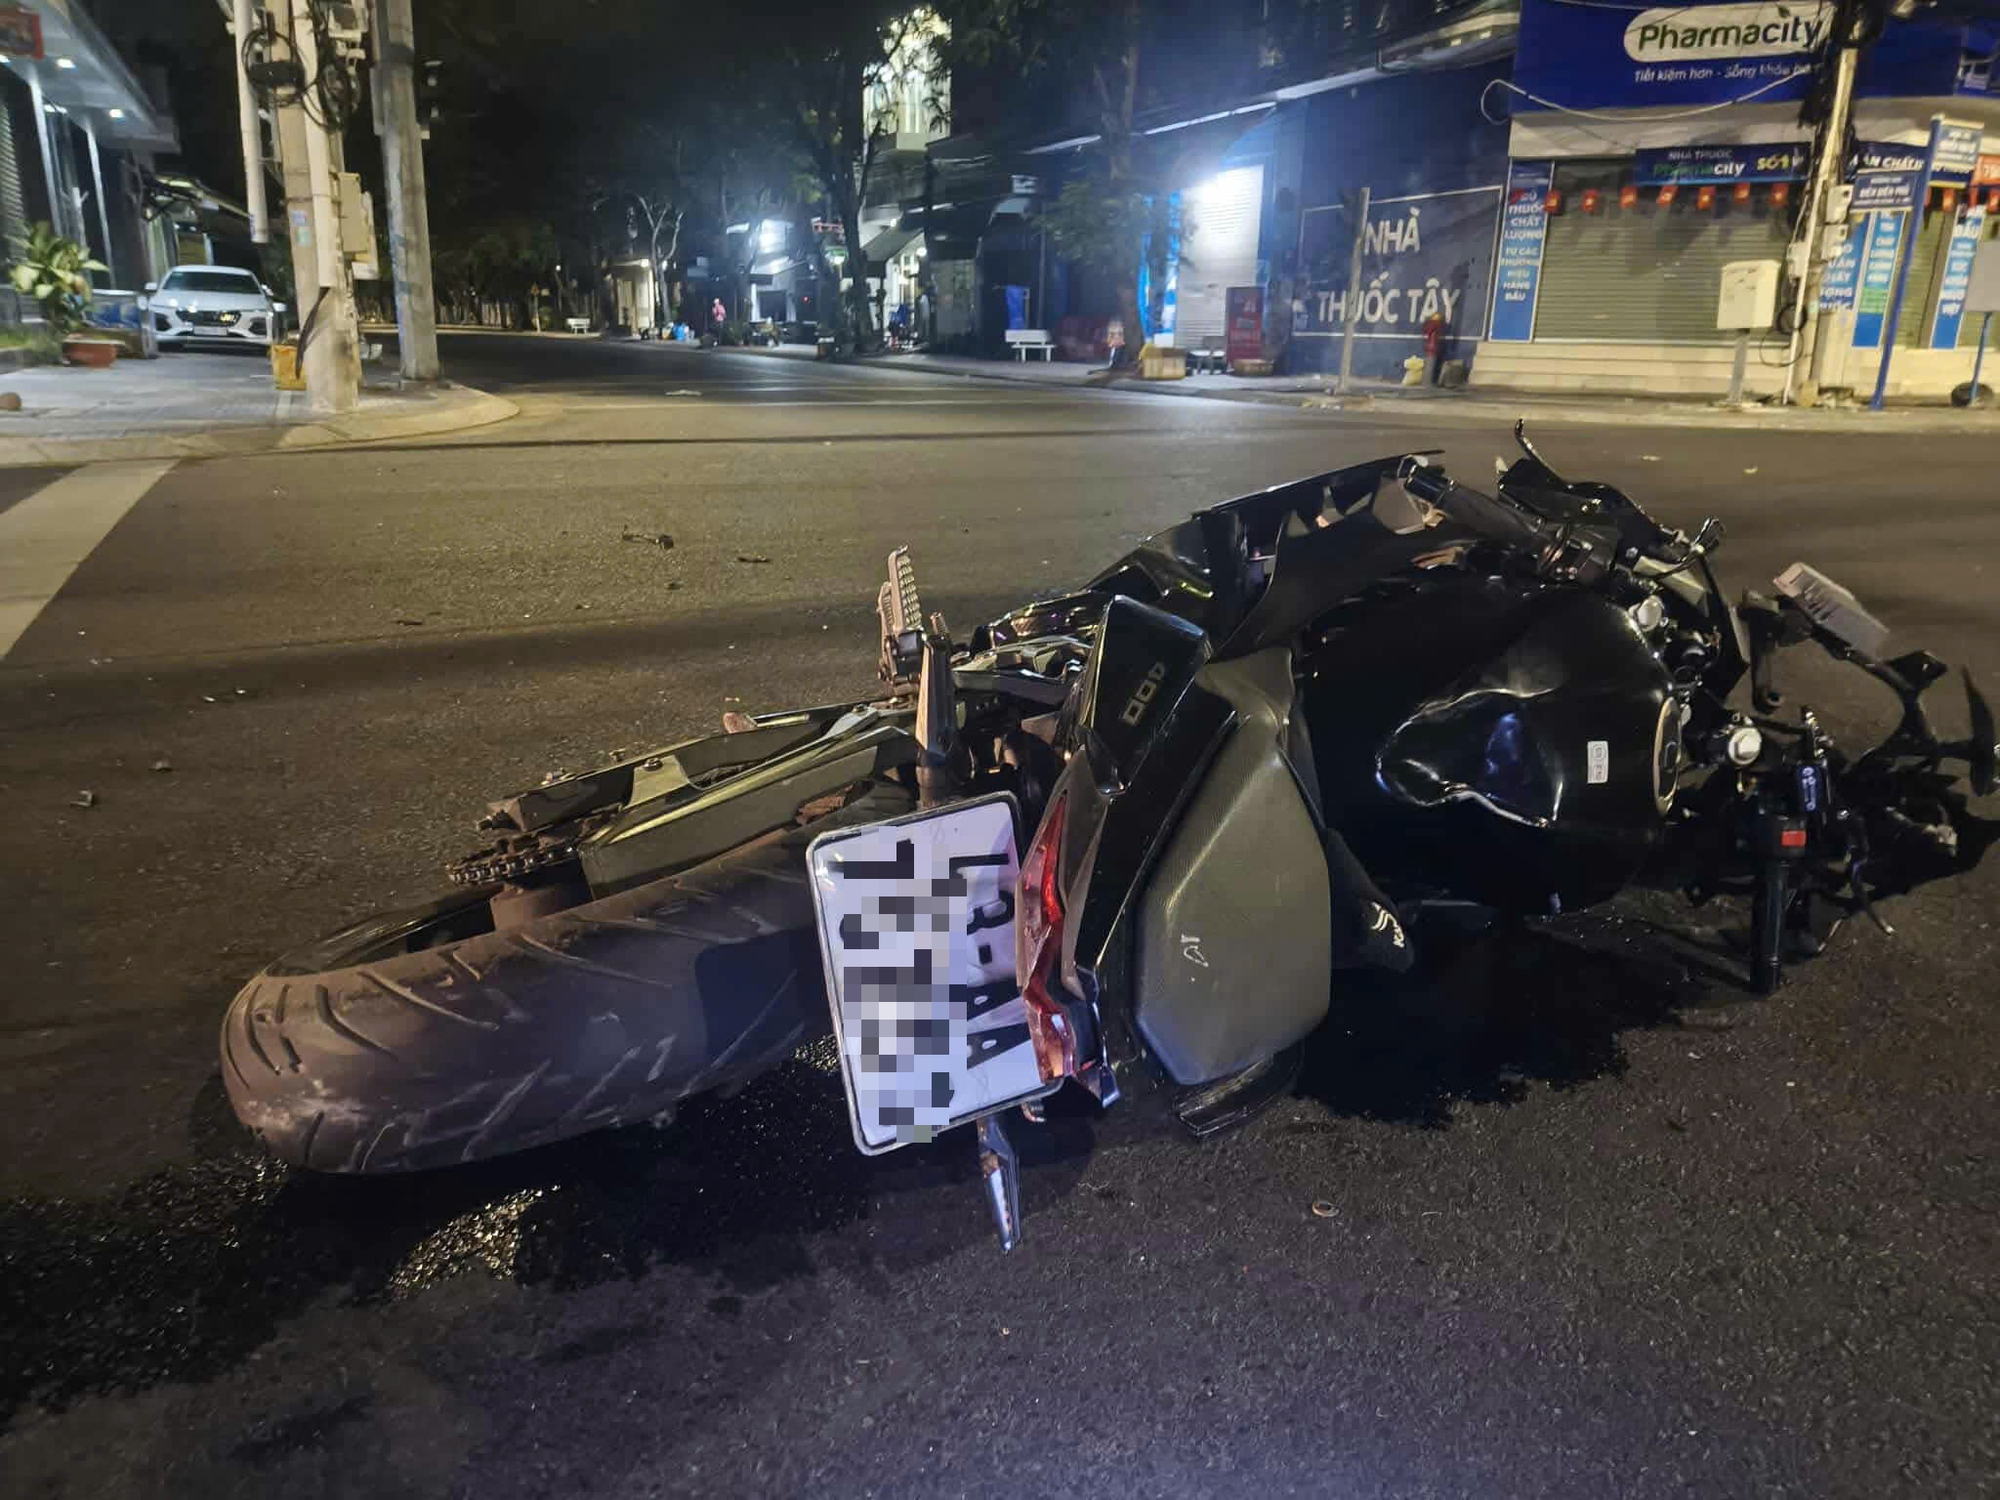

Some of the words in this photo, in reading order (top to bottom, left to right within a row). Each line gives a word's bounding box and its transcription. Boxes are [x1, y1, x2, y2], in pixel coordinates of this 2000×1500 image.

[1638, 7, 1822, 50] Pharmacity
[1363, 206, 1421, 256] NHÀ
[1317, 271, 1401, 323] THUỐC
[1407, 277, 1462, 324] TÂY
